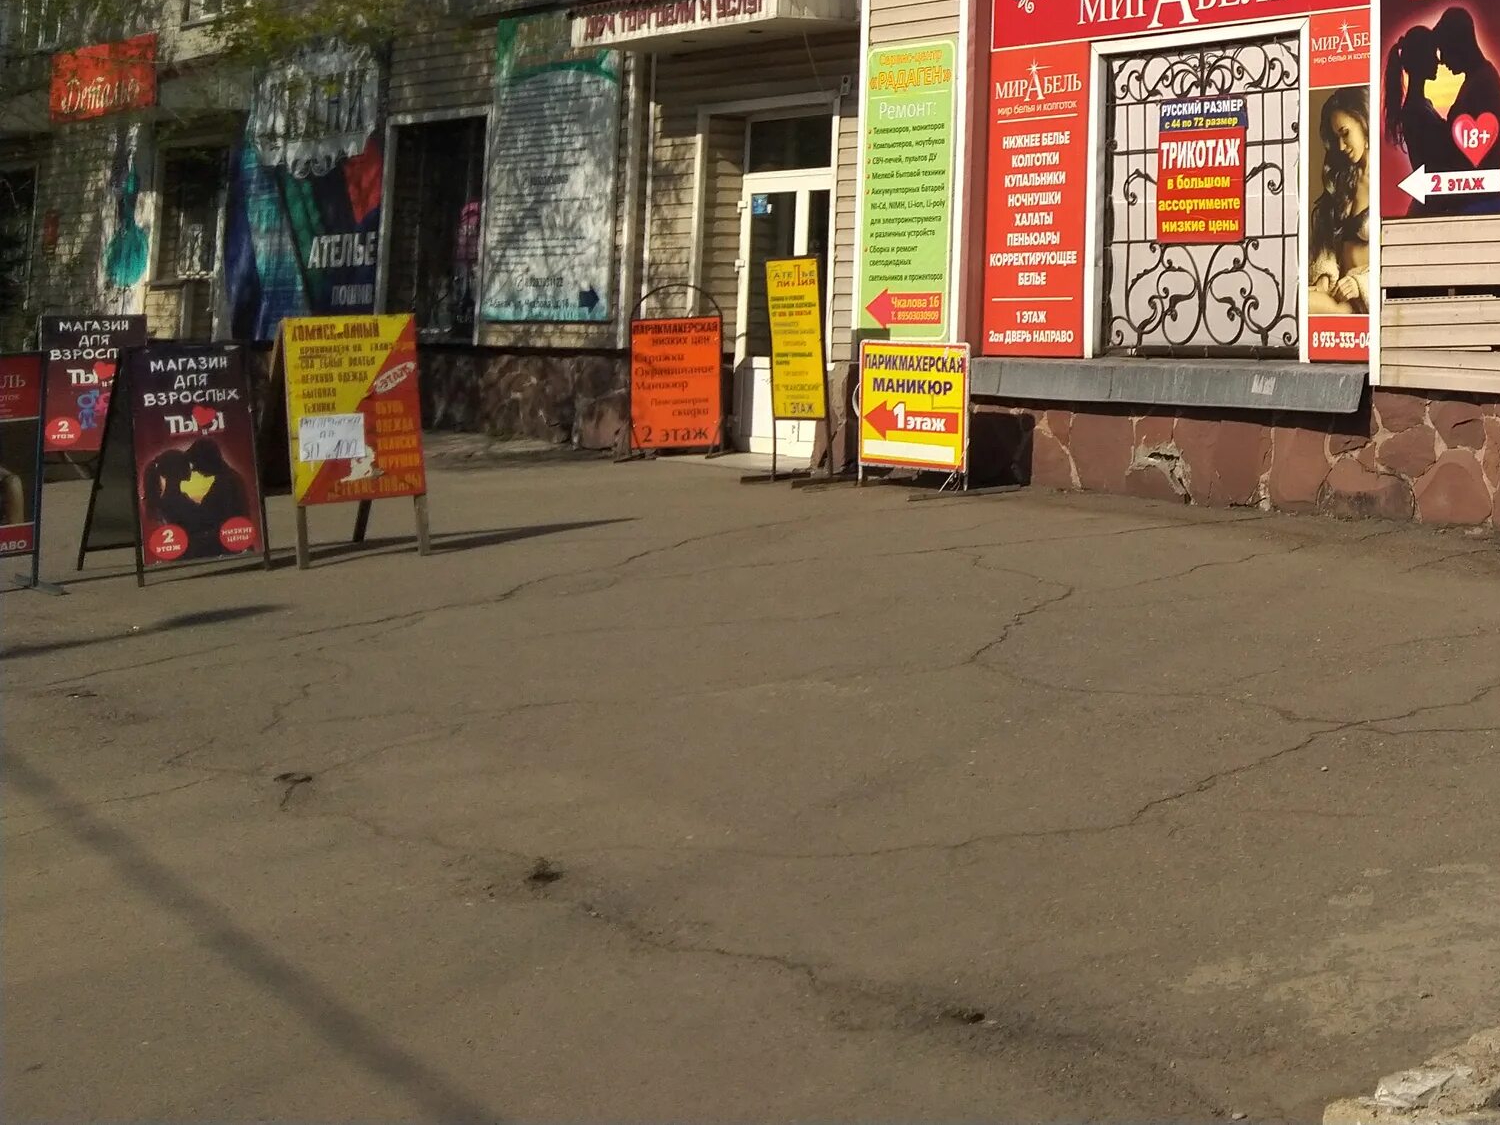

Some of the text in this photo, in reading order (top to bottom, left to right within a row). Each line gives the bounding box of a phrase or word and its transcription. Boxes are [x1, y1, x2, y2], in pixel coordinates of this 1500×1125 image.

[1311, 30, 1370, 53] МИРАБЕ
[880, 50, 943, 66] Сервис-центр
[869, 65, 952, 92] «РАДАГЕН»
[995, 71, 1082, 102] МИРАБЕЛЬ
[880, 101, 937, 119] Ремонт:
[997, 106, 1013, 116] мир
[1014, 104, 1035, 114] белья
[1043, 100, 1078, 111] колготок
[1161, 99, 1244, 117] РУССКИЙ РАЗМЕР
[912, 123, 945, 131] мониторов
[1171, 119, 1181, 128] 44
[1182, 119, 1192, 128] по
[1193, 117, 1204, 126] 72
[1205, 116, 1238, 128] размер
[915, 137, 945, 147] ноутбуков
[1003, 130, 1071, 149] НИЖНЕЕ БЕЛЬЕ
[1463, 128, 1491, 148] 18+
[1012, 151, 1060, 168] КОЛГОТКИ
[1161, 138, 1240, 170] ТРИКОТАЖ
[1004, 171, 1066, 188] КУПАЛЬНИКИ
[1167, 174, 1231, 190] в большом
[1431, 174, 1485, 193] 2 ЭТАЖ
[1008, 192, 1062, 208] НОЧНУШКИ
[1158, 197, 1241, 214] ассортименте
[1014, 212, 1053, 227] ХАЛАТЫ
[1162, 218, 1239, 233] низкие цены
[1007, 231, 1060, 247] ПЕНЬЮАРЫ
[308, 231, 377, 269] АТЕЛЬЕ
[989, 250, 1078, 267] КОРРЕКТИРУЮЩЕЕ
[1018, 271, 1047, 286] БЕЛЬЕ
[891, 294, 940, 308] Чкалова 16
[59, 319, 130, 332] МАГАЗИН
[1022, 311, 1047, 324] ЭТАЖ
[291, 320, 379, 341] КОМИССОННЫЙ
[1004, 330, 1032, 345] ДВЕРЬ
[1033, 330, 1074, 343] НАПРАВО
[78, 334, 111, 348] ДЛЯ
[1312, 331, 1319, 348] 8
[50, 347, 119, 361] ВЗРОСЛ
[150, 356, 228, 373] МАГАЗИН
[864, 353, 964, 373] ПАРИКМАХЕРСКАЯ
[173, 373, 209, 390] ДЛЯ
[872, 377, 953, 395] МАНИКЮР
[143, 388, 240, 407] ВЗРОСЛЫХ
[892, 401, 948, 432] 1 этаж
[58, 420, 69, 432] 2
[641, 425, 708, 443] 2 этаж
[162, 529, 174, 544] 2
